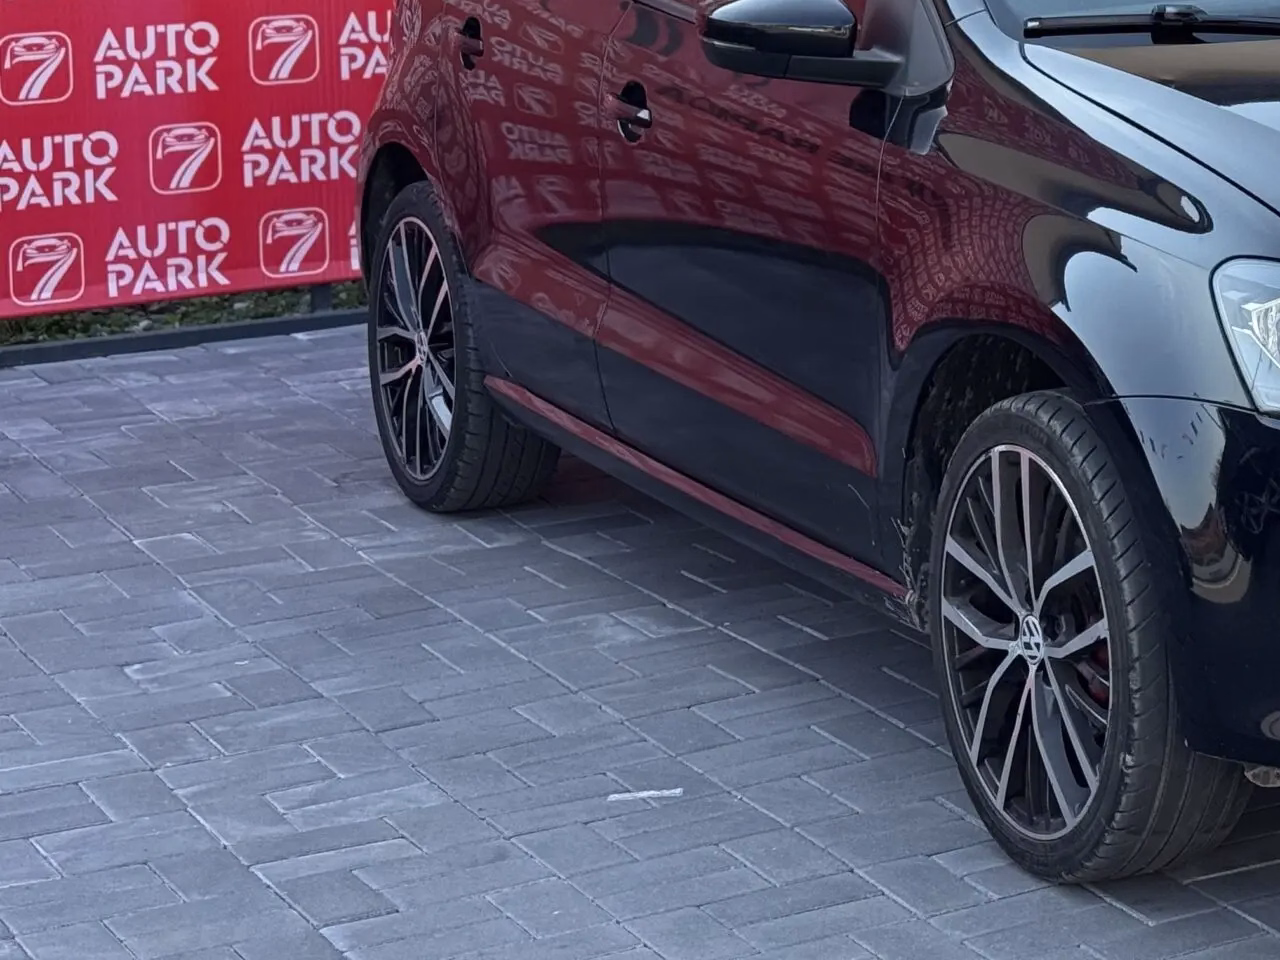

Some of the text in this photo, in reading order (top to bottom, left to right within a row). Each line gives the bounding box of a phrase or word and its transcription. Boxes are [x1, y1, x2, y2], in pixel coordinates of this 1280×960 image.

[94, 22, 219, 62] AUTO
[339, 10, 391, 44] AU
[96, 57, 218, 99] PARK
[340, 46, 388, 80] PA
[242, 111, 360, 151] AUTO
[244, 146, 358, 187] PARK
[106, 218, 229, 261] AUTO
[108, 253, 230, 297] PARK
